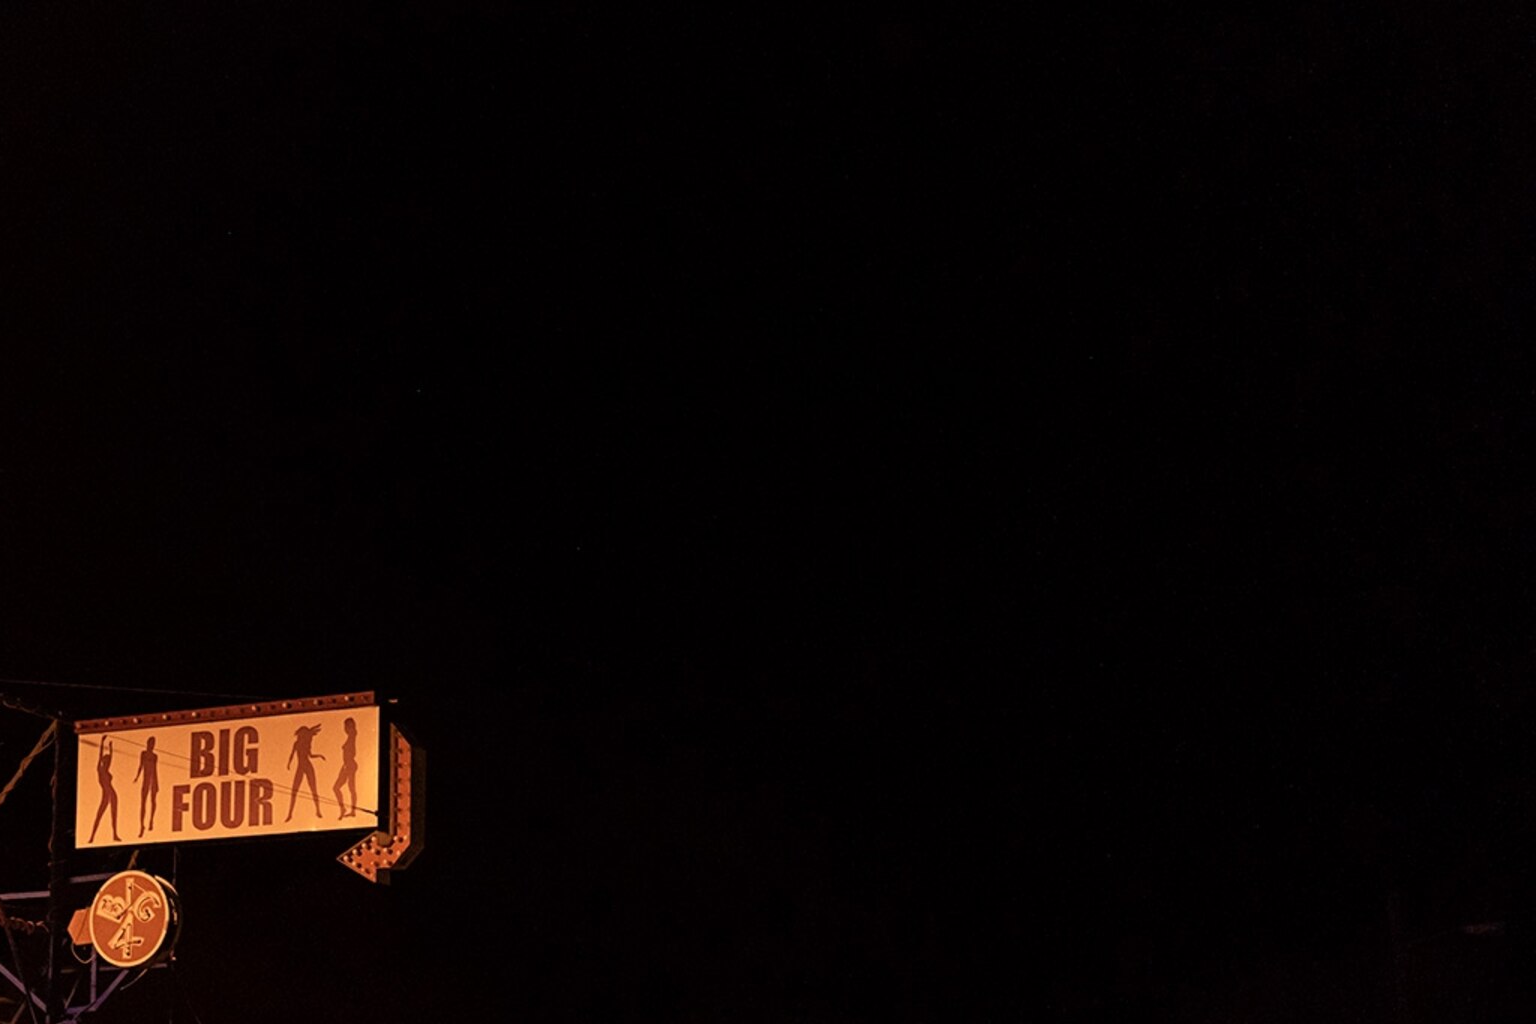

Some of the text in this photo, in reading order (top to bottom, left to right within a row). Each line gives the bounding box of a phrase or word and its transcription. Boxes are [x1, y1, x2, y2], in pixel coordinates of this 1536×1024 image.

[190, 725, 259, 778] BIG
[172, 778, 274, 832] FOUR
[108, 912, 144, 959] 4
